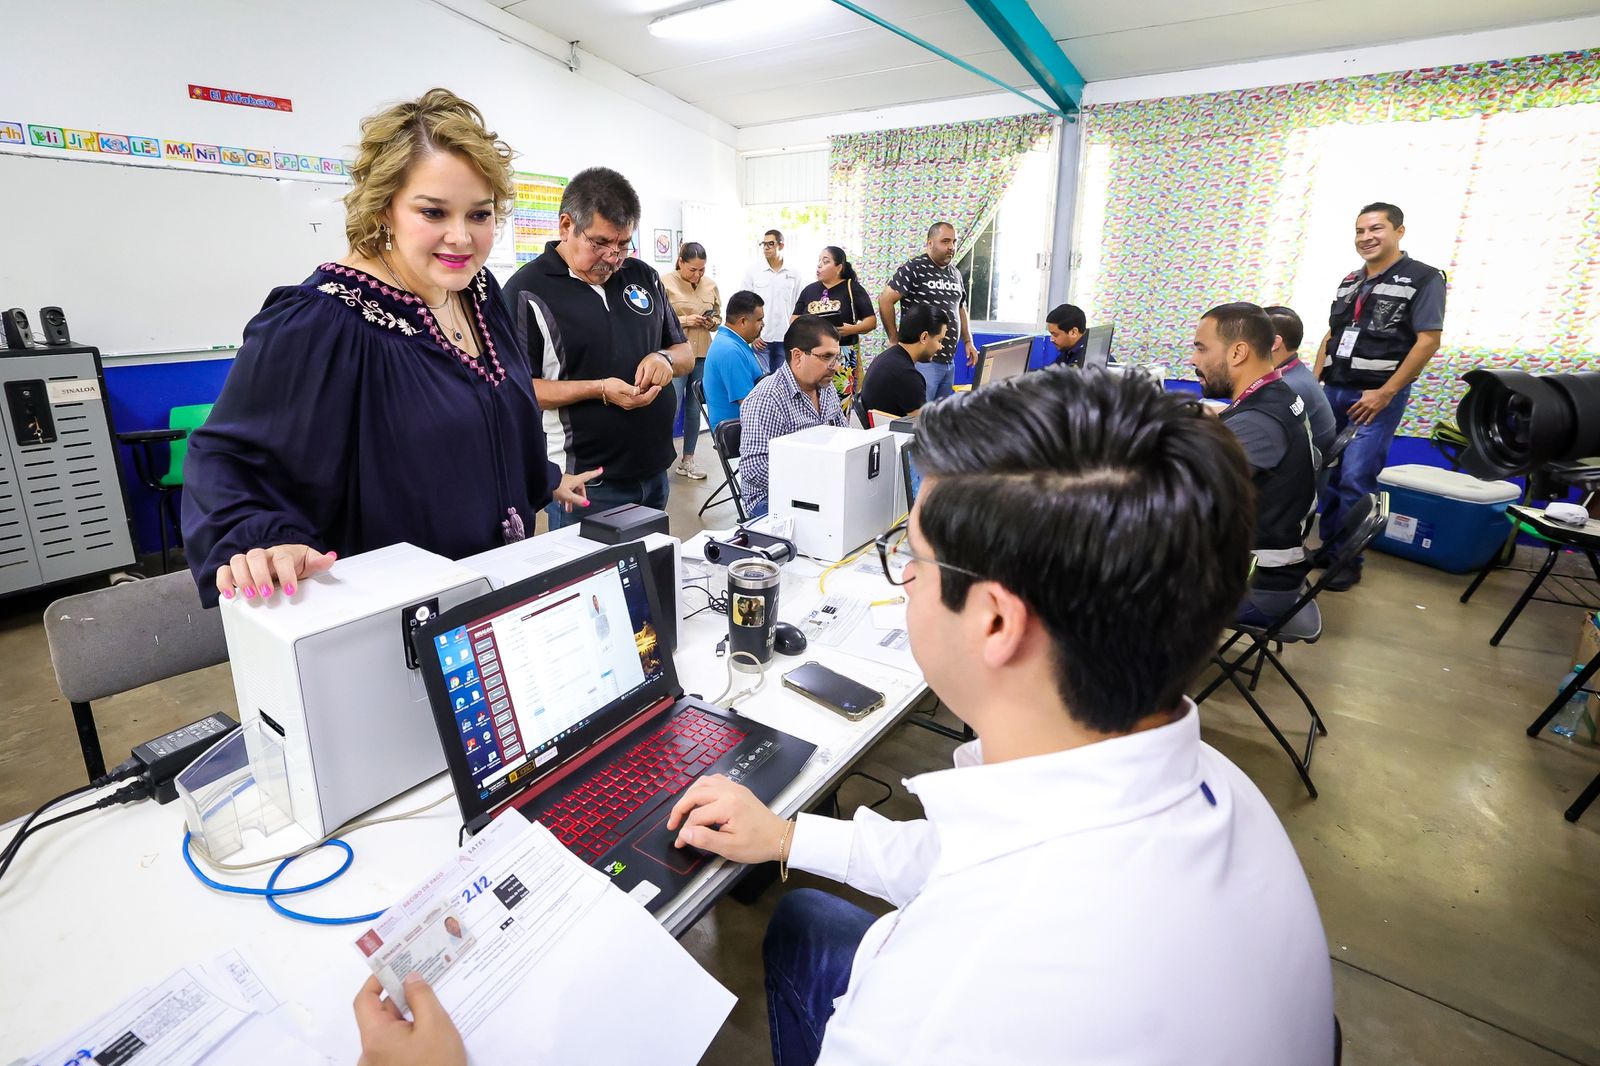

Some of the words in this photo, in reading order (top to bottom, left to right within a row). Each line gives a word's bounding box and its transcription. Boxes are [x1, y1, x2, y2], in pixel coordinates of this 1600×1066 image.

[210, 90, 221, 100] El
[224, 92, 276, 108] Alfabeto
[62, 386, 96, 394] SINALOA
[467, 838, 486, 854] SATES
[462, 875, 493, 904] 212
